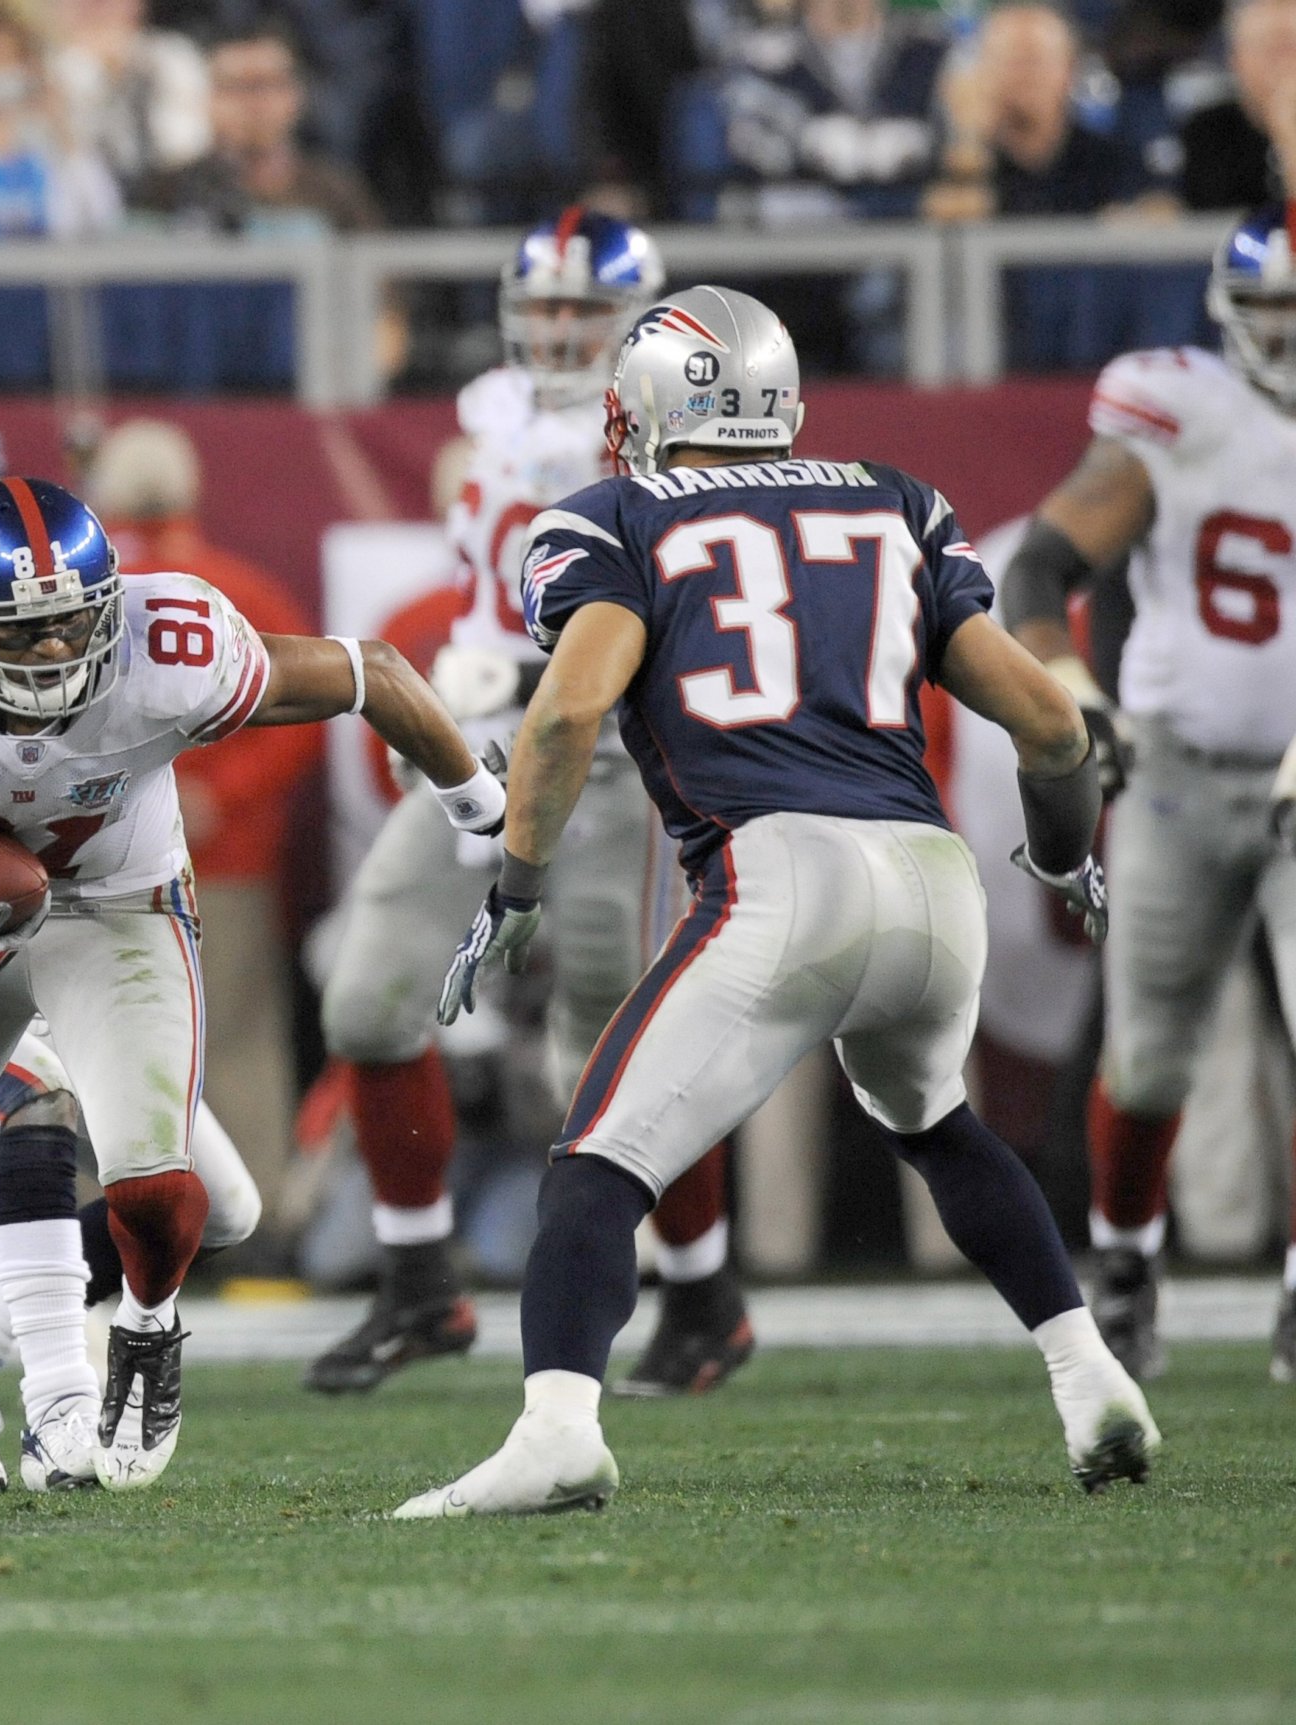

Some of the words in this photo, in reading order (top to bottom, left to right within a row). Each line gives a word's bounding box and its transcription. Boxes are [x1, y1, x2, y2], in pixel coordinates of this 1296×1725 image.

[688, 356, 714, 381] 91
[717, 427, 780, 440] PATRIOTS
[630, 459, 879, 501] HARRISON
[144, 597, 214, 668] 81
[652, 508, 925, 731] 37
